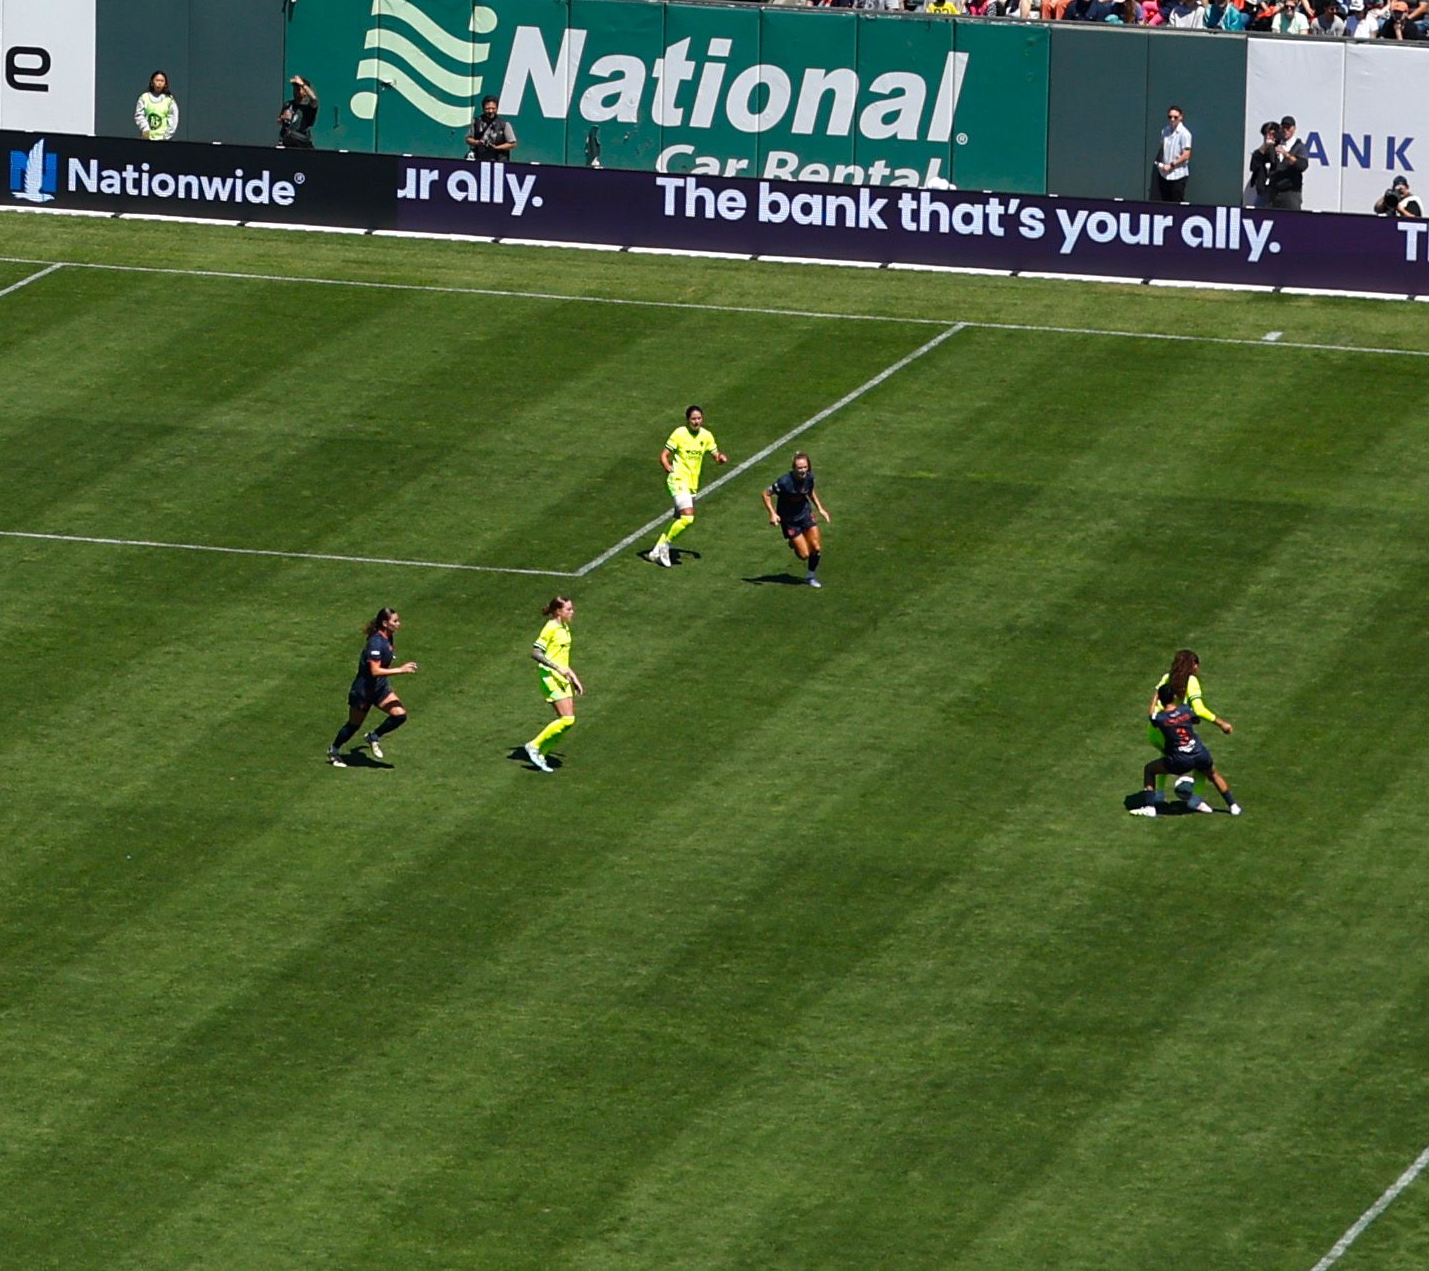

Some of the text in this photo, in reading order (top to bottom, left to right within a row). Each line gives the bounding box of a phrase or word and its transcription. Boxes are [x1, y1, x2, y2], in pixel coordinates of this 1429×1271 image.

[497, 26, 970, 144] National
[656, 144, 943, 189] Car Rental
[1301, 130, 1416, 172] ANK
[446, 162, 544, 209] ally.
[656, 176, 1282, 262] The bank that's your ally.
